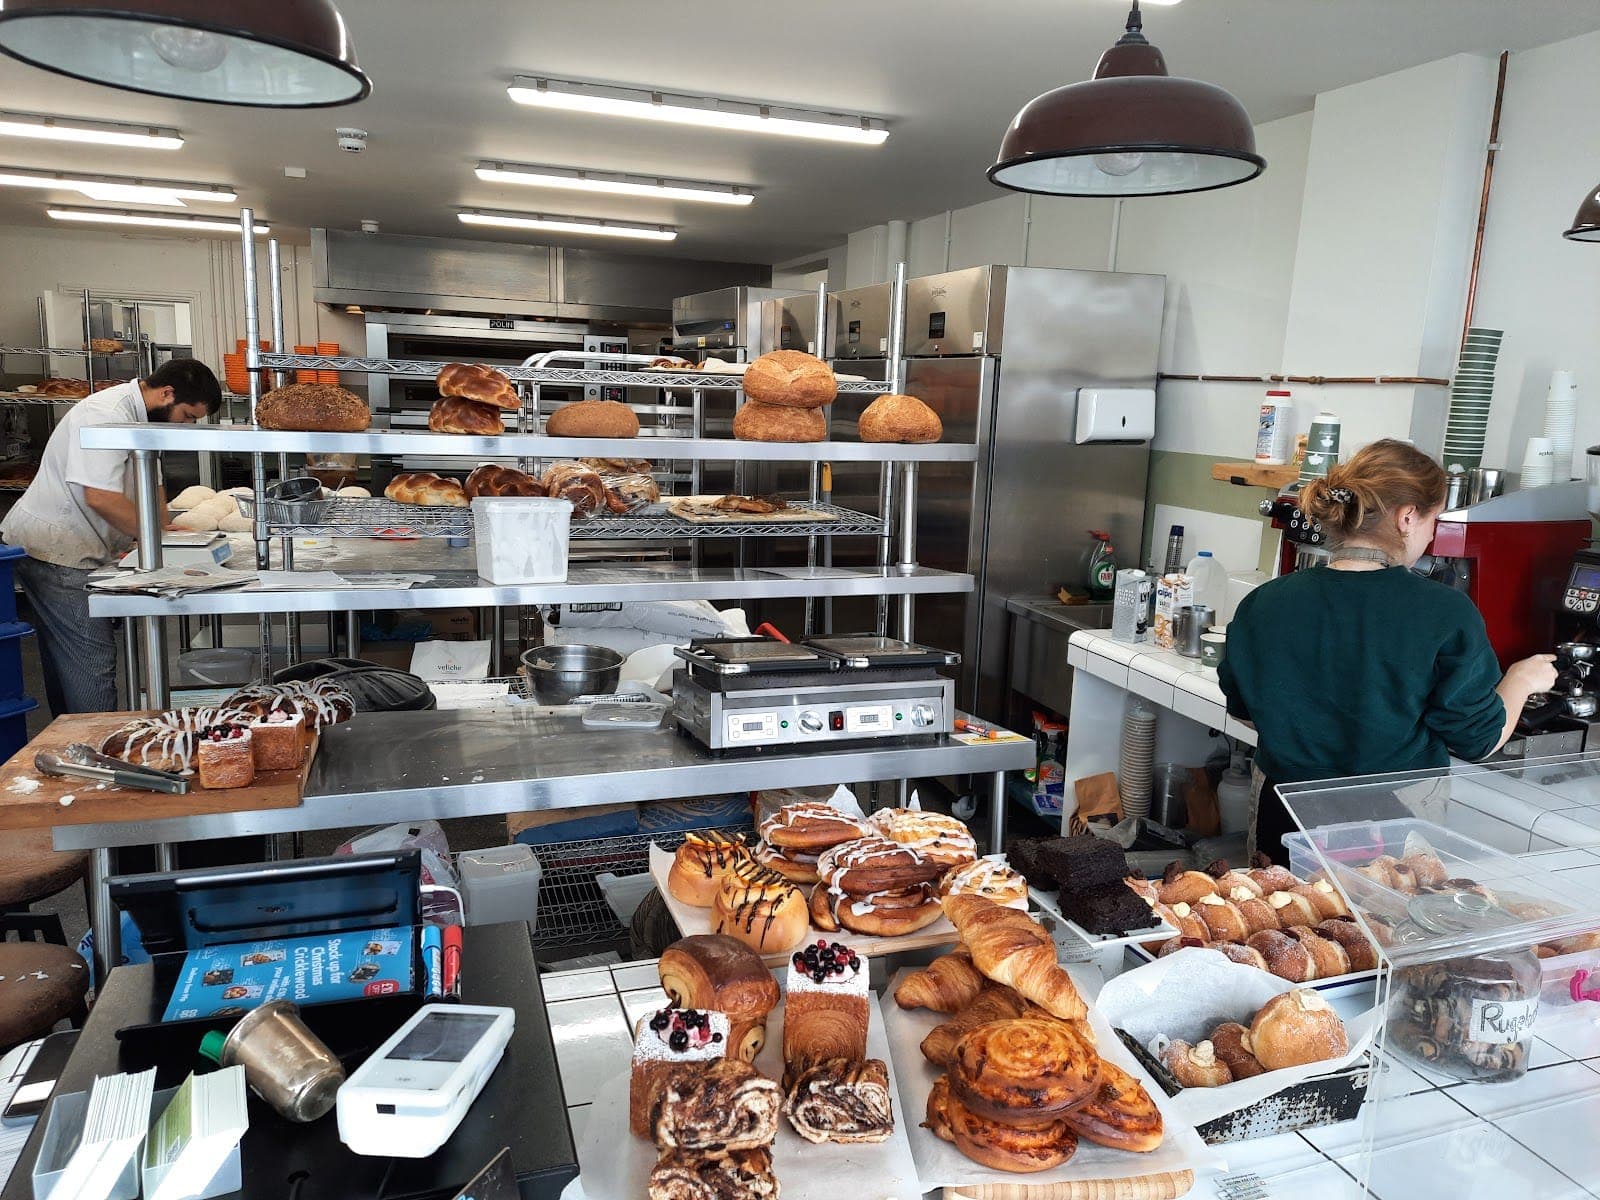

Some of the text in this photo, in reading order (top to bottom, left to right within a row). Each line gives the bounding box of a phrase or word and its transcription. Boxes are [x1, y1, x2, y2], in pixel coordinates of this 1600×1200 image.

[490, 320, 513, 328] POLIN
[294, 946, 310, 1000] Cricklewood
[312, 947, 326, 986] Christmas
[326, 938, 344, 984] Stock up for
